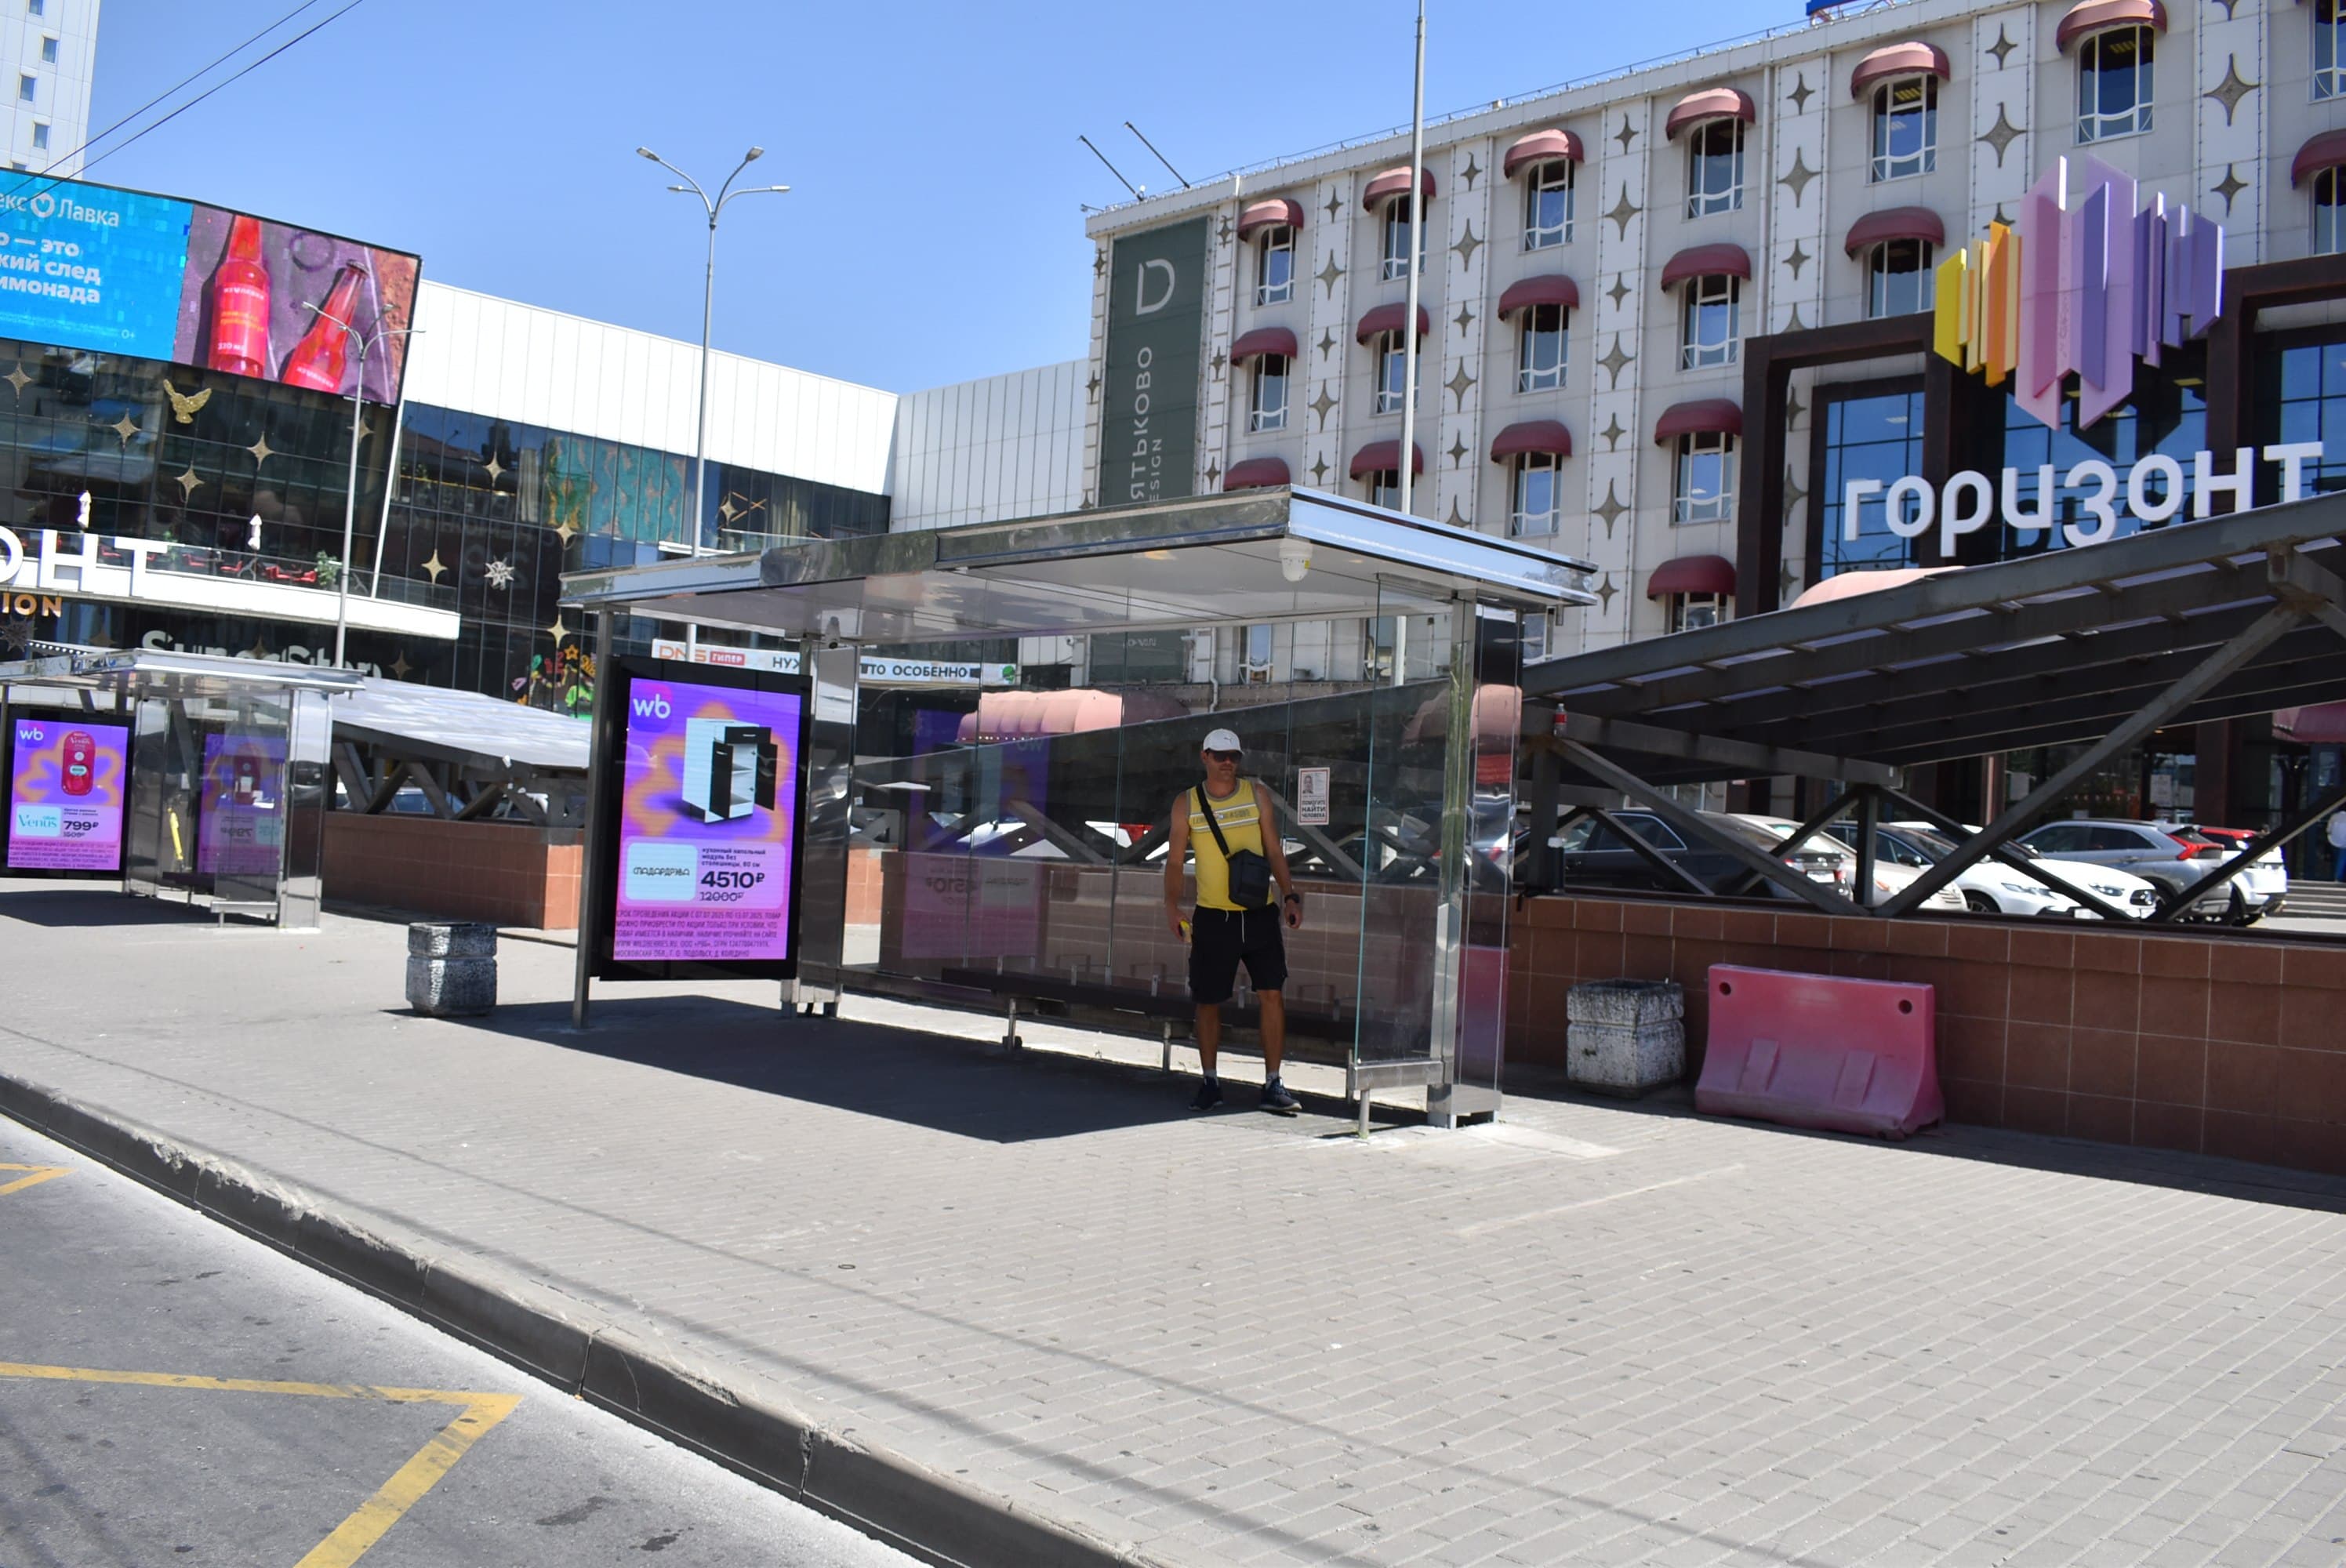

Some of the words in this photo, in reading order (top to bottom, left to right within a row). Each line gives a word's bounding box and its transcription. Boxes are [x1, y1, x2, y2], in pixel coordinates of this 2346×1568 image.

[57, 198, 120, 227] Лавка
[41, 238, 79, 257] это
[45, 261, 101, 285] след
[1135, 259, 1175, 315] D
[121, 329, 136, 339] 0+
[1131, 347, 1153, 500] ЯТЬКОВО
[1149, 439, 1162, 502] ESIGN
[2, 591, 63, 618] ION
[712, 652, 743, 664] ГИПЕР
[892, 665, 968, 678] ОСОБЕННО
[633, 694, 671, 719] wb
[20, 728, 44, 741] wb
[19, 813, 57, 828] Venus
